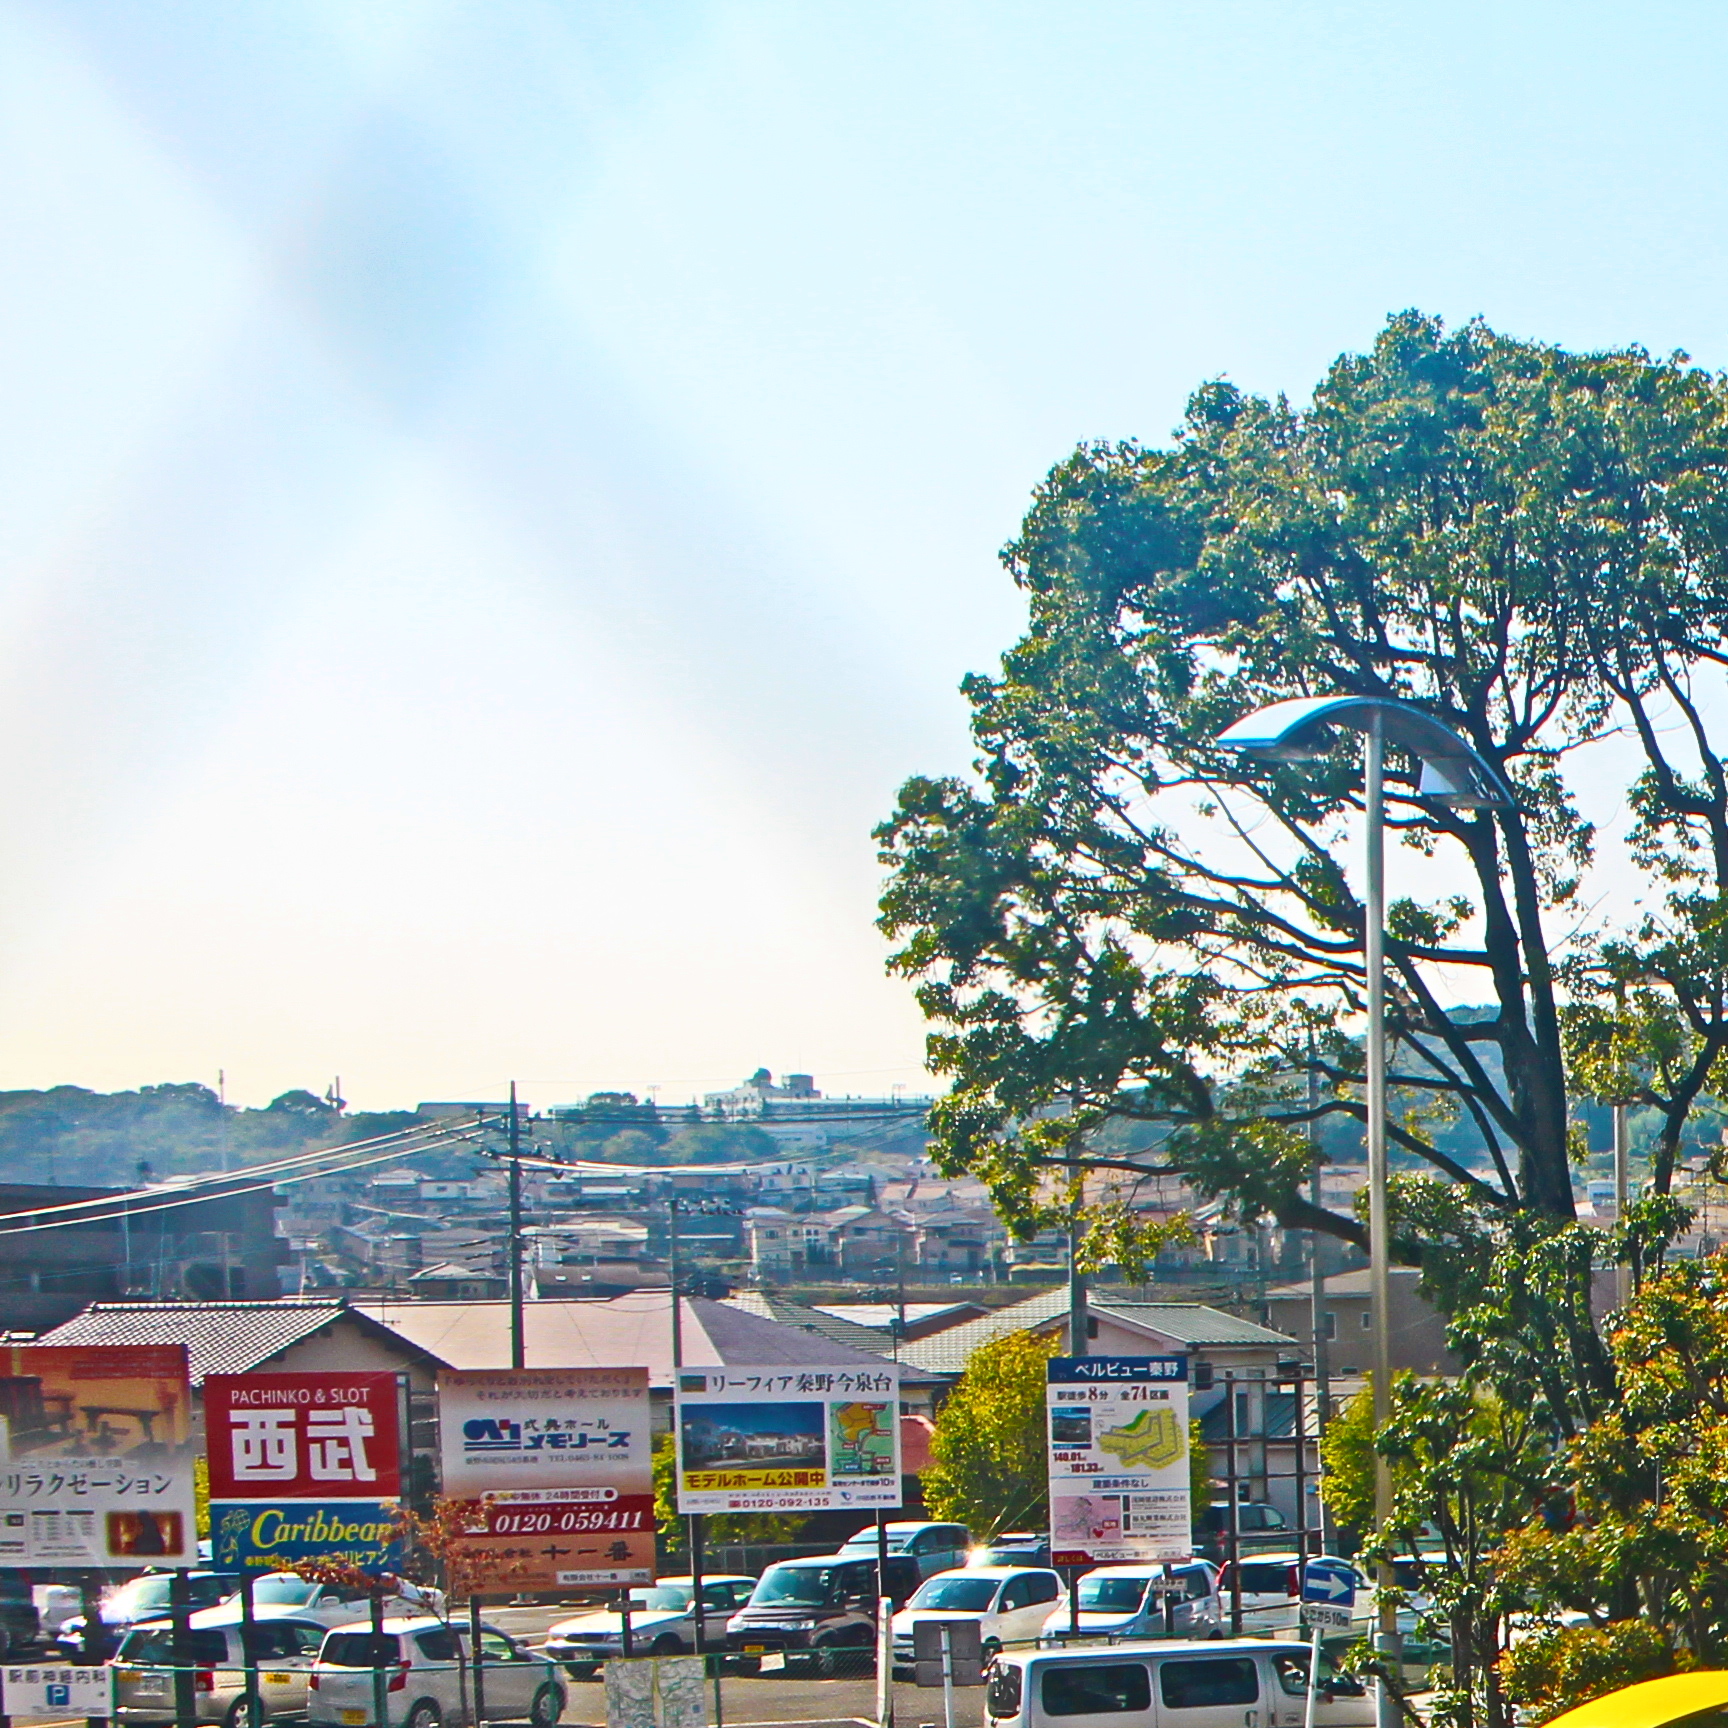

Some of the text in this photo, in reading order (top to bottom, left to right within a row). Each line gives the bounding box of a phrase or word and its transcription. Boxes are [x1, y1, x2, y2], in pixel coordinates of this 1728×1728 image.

[1074, 1361, 1179, 1377] ベルビュー秦野
[231, 1387, 371, 1404] PACHINKO & SLOT
[523, 1418, 611, 1431] 式典ホール
[229, 1405, 377, 1482] 西武
[0, 1473, 172, 1497] リラクゼーション
[686, 1471, 825, 1488] モデルホーム公開中
[742, 1497, 830, 1508] 0120-092-135
[495, 1511, 642, 1534] 0120-059411
